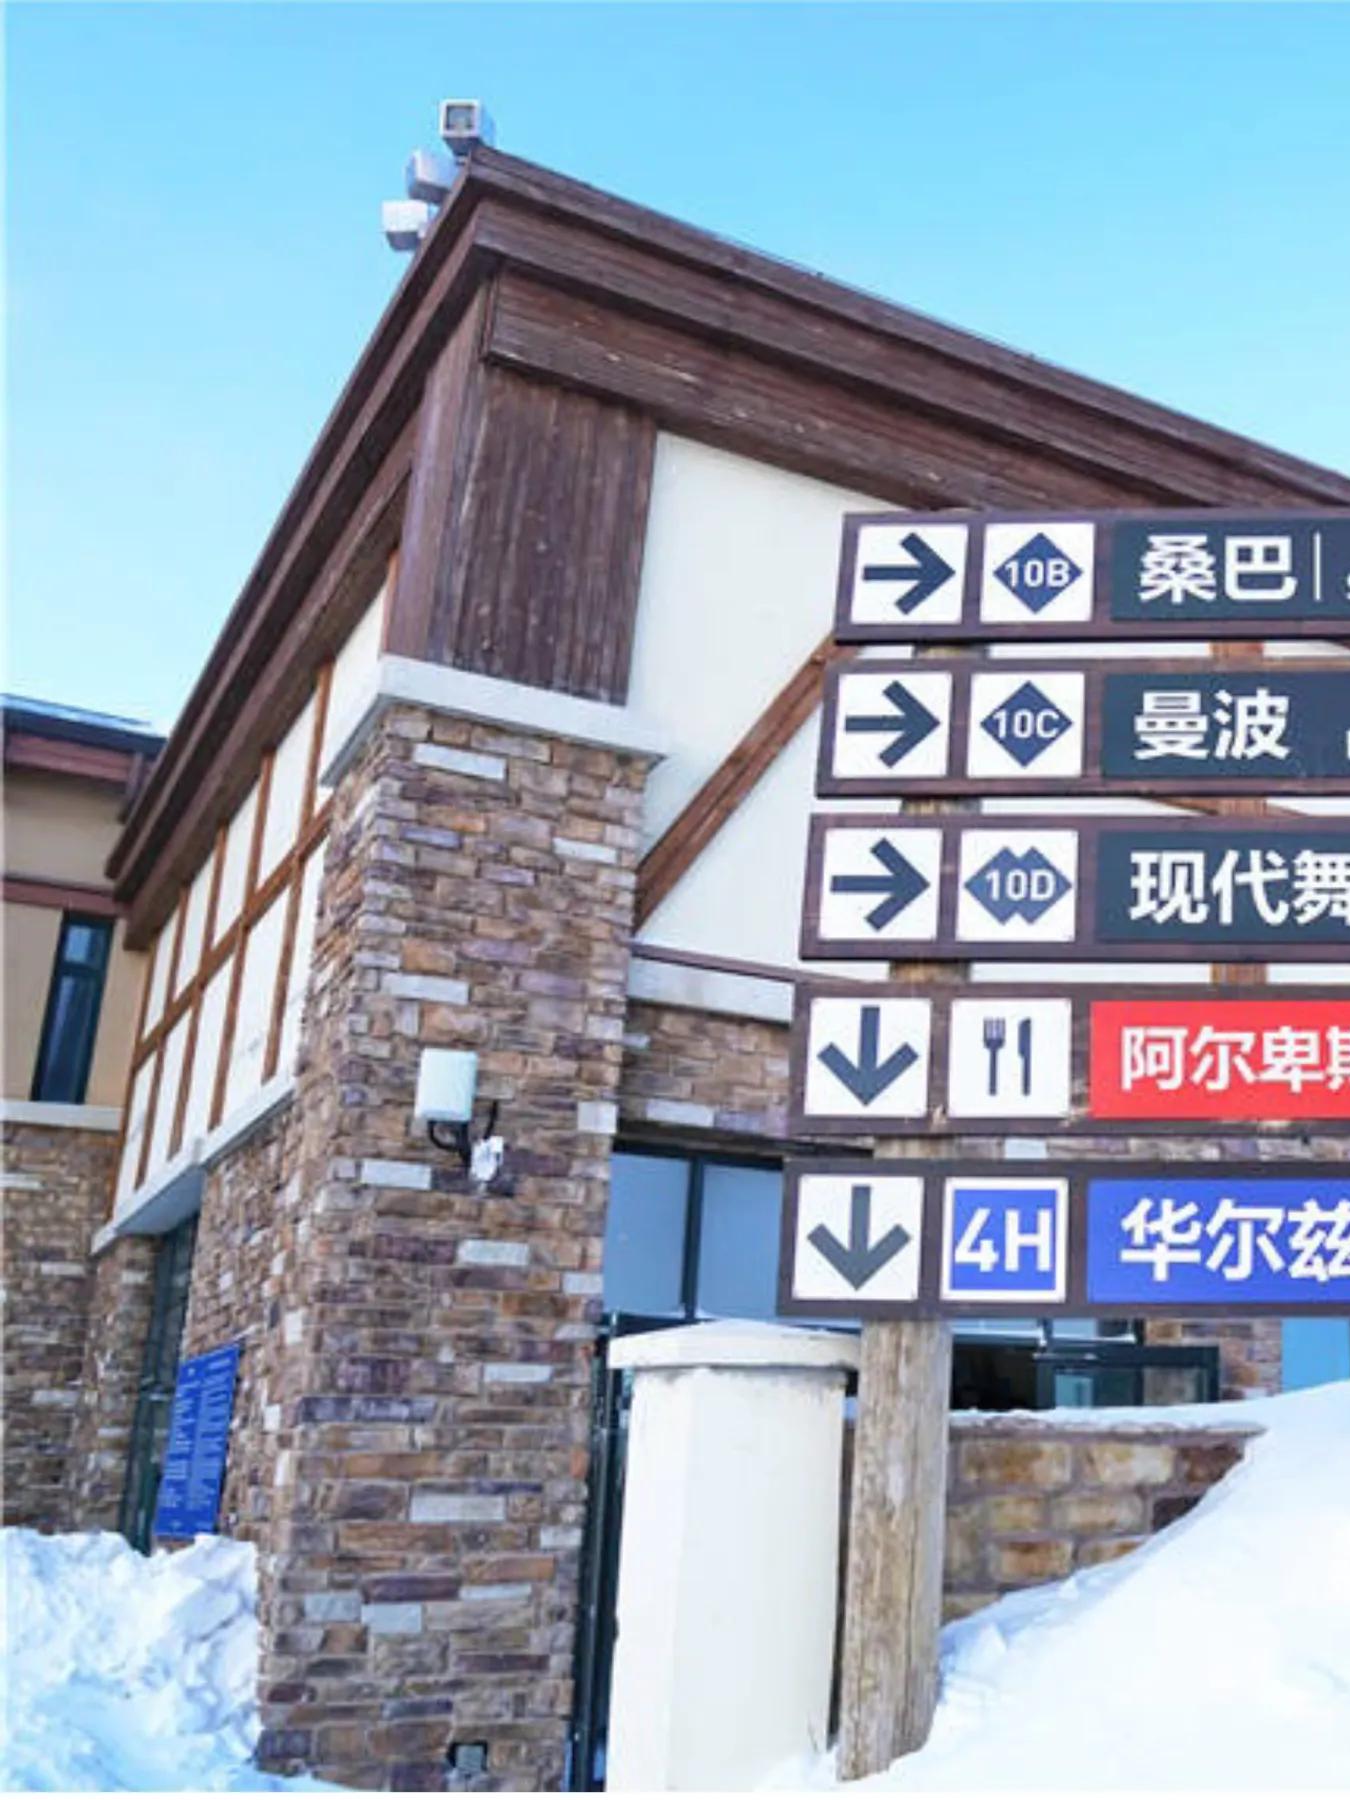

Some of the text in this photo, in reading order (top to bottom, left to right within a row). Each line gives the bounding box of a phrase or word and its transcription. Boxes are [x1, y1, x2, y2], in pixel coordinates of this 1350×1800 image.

[1003, 557, 1071, 589] 10B
[1138, 533, 1298, 605] 桑巴
[992, 707, 1060, 741] 10C
[1133, 688, 1291, 761] 曼波
[985, 869, 1056, 903] 10D
[955, 1208, 1055, 1272] 4H
